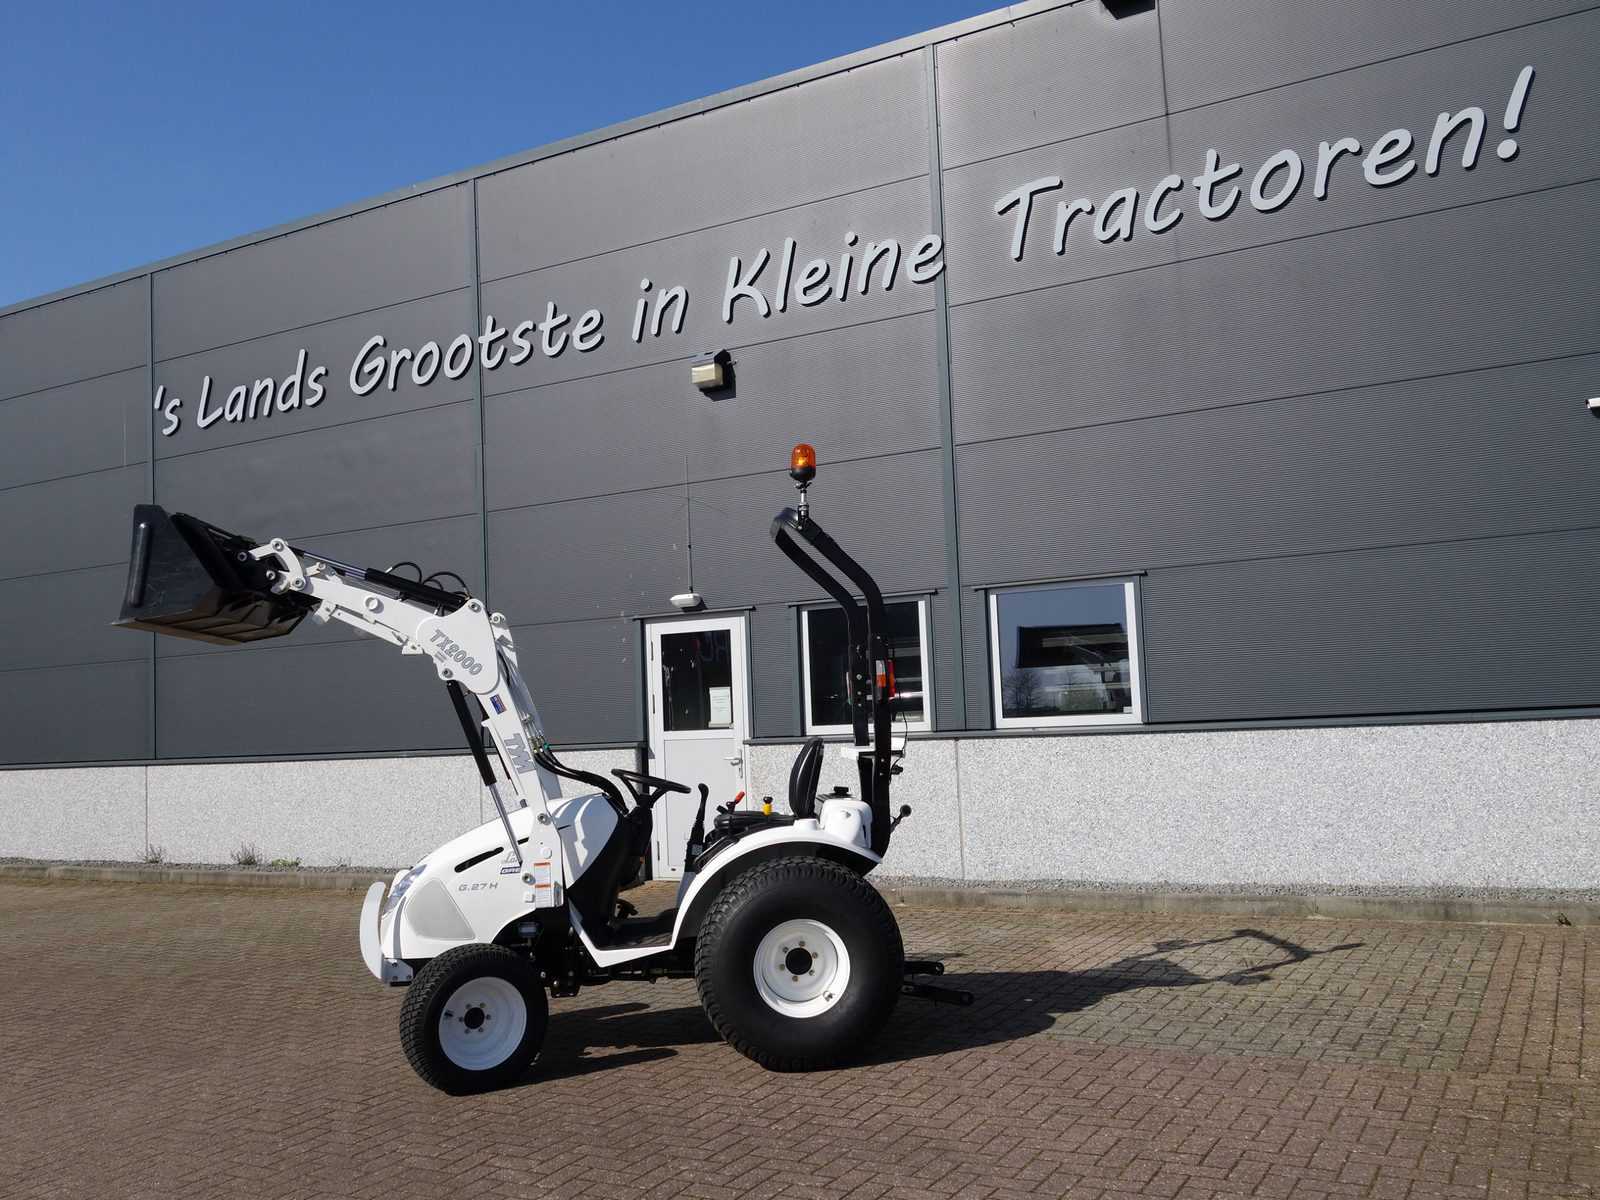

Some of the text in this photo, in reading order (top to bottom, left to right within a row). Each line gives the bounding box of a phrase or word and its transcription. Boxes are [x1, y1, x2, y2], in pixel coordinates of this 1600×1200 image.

[154, 66, 1534, 436] 's Lands Grootste in Kleine Tractoren!
[429, 628, 483, 676] TX2000
